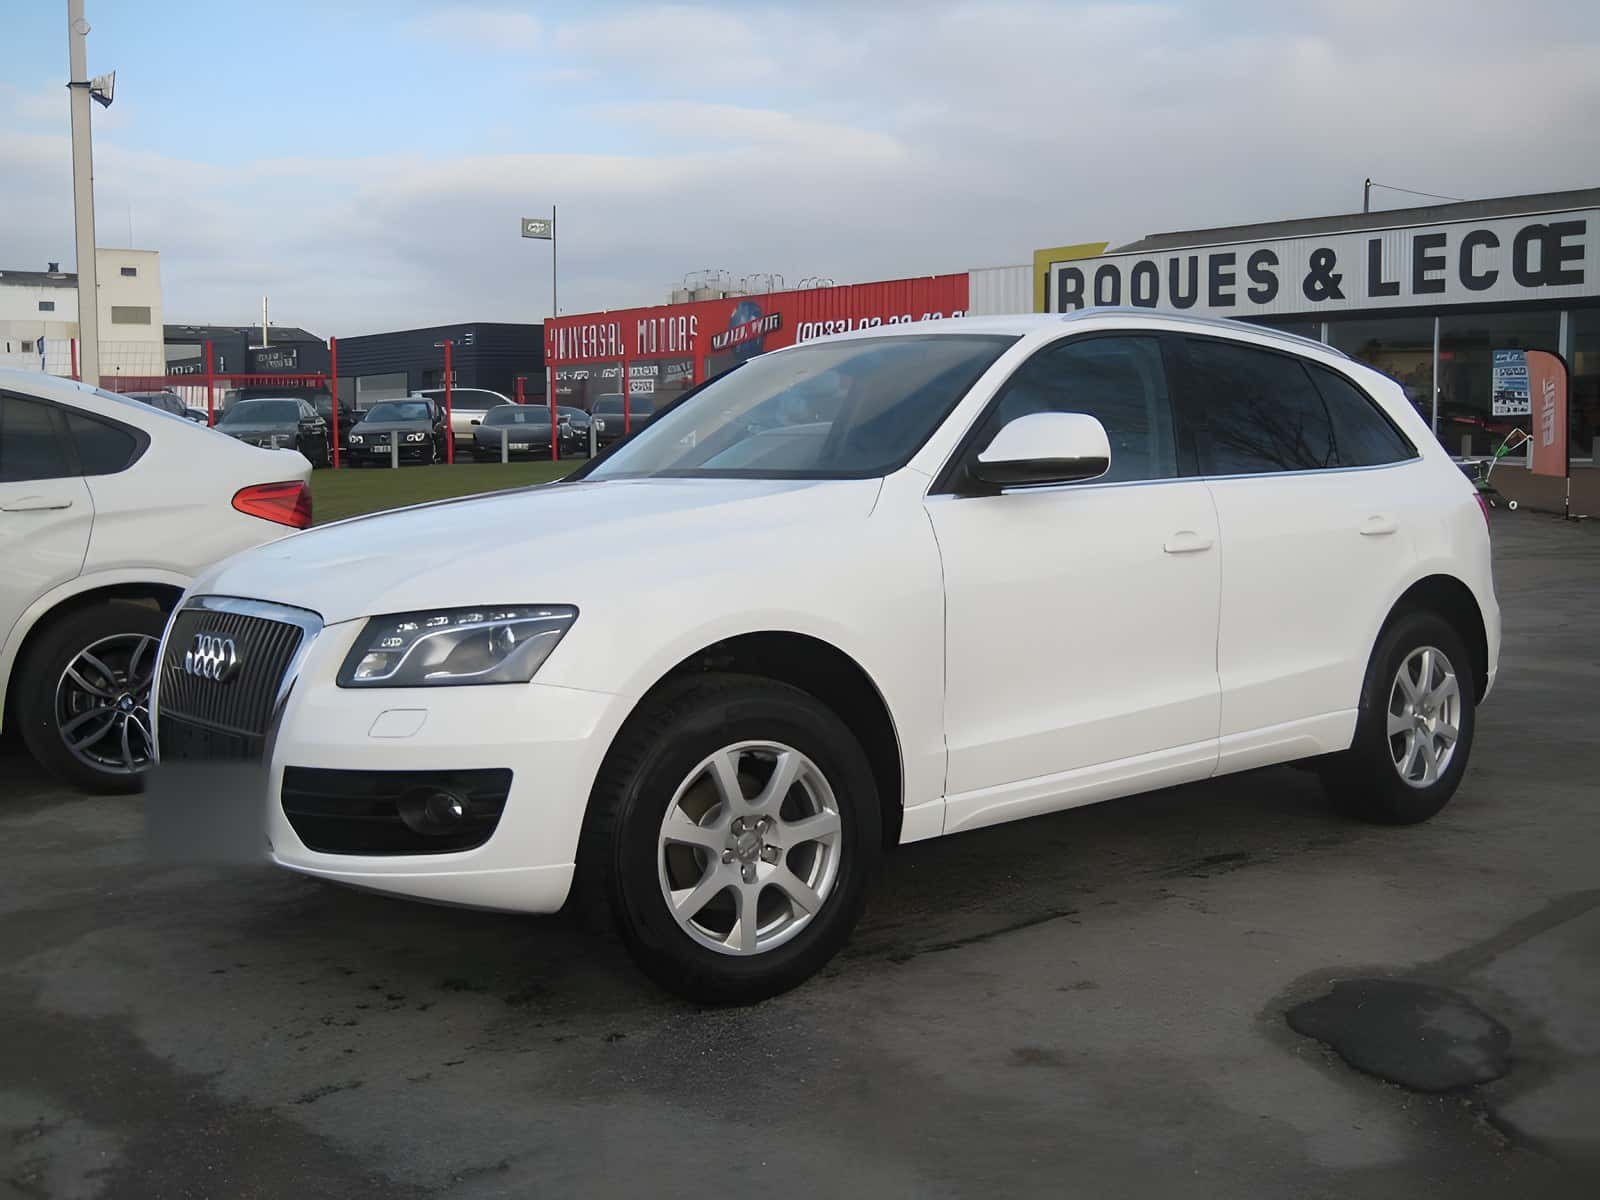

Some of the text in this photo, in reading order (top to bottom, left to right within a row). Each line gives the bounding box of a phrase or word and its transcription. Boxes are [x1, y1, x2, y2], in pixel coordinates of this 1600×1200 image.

[1057, 248, 1280, 314] ROQUES
[1302, 247, 1346, 302] &
[637, 314, 699, 355] MOTORS
